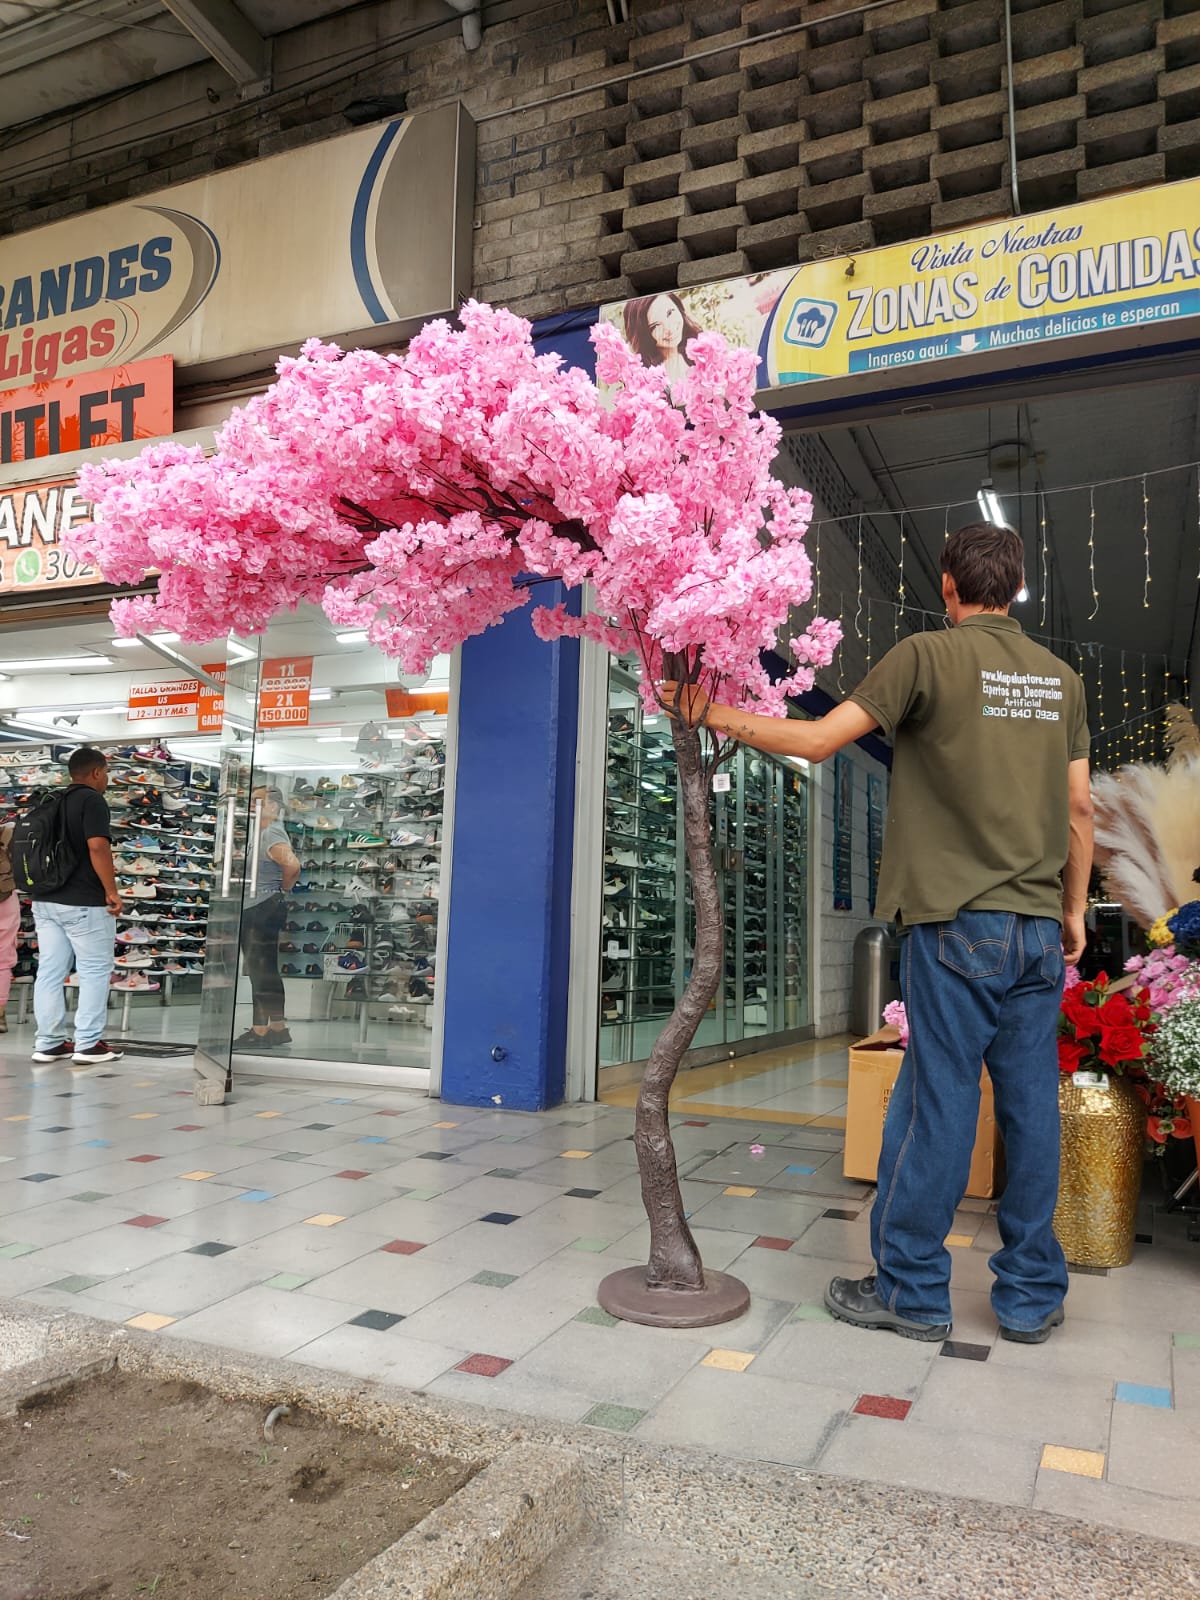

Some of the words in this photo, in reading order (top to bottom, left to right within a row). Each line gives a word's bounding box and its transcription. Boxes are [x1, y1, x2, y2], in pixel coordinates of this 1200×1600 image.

[911, 241, 974, 273] Visita
[981, 222, 1084, 259] Nuestras
[0, 236, 173, 332] ANDES
[846, 271, 979, 341] ZONAS
[984, 276, 1012, 302] de
[868, 348, 915, 368] Ingreso
[919, 339, 949, 359] aquí
[989, 325, 1041, 347] Muchas
[1044, 315, 1098, 337] delicias
[1102, 311, 1116, 326] te
[1120, 302, 1180, 324] esperan
[0, 318, 116, 384] Ligas
[131, 685, 158, 695] TALLAS
[160, 682, 198, 693] GRANDES
[982, 681, 1010, 698] Expertos
[1012, 688, 1021, 697] en
[157, 696, 168, 704] US
[276, 694, 284, 706] 2
[1004, 697, 1042, 707] Artificial
[136, 709, 146, 717] 12
[153, 708, 162, 716] 13
[164, 707, 170, 716] Y
[171, 706, 189, 715] MAS
[262, 708, 306, 721] 150.000
[1011, 708, 1032, 719] 640
